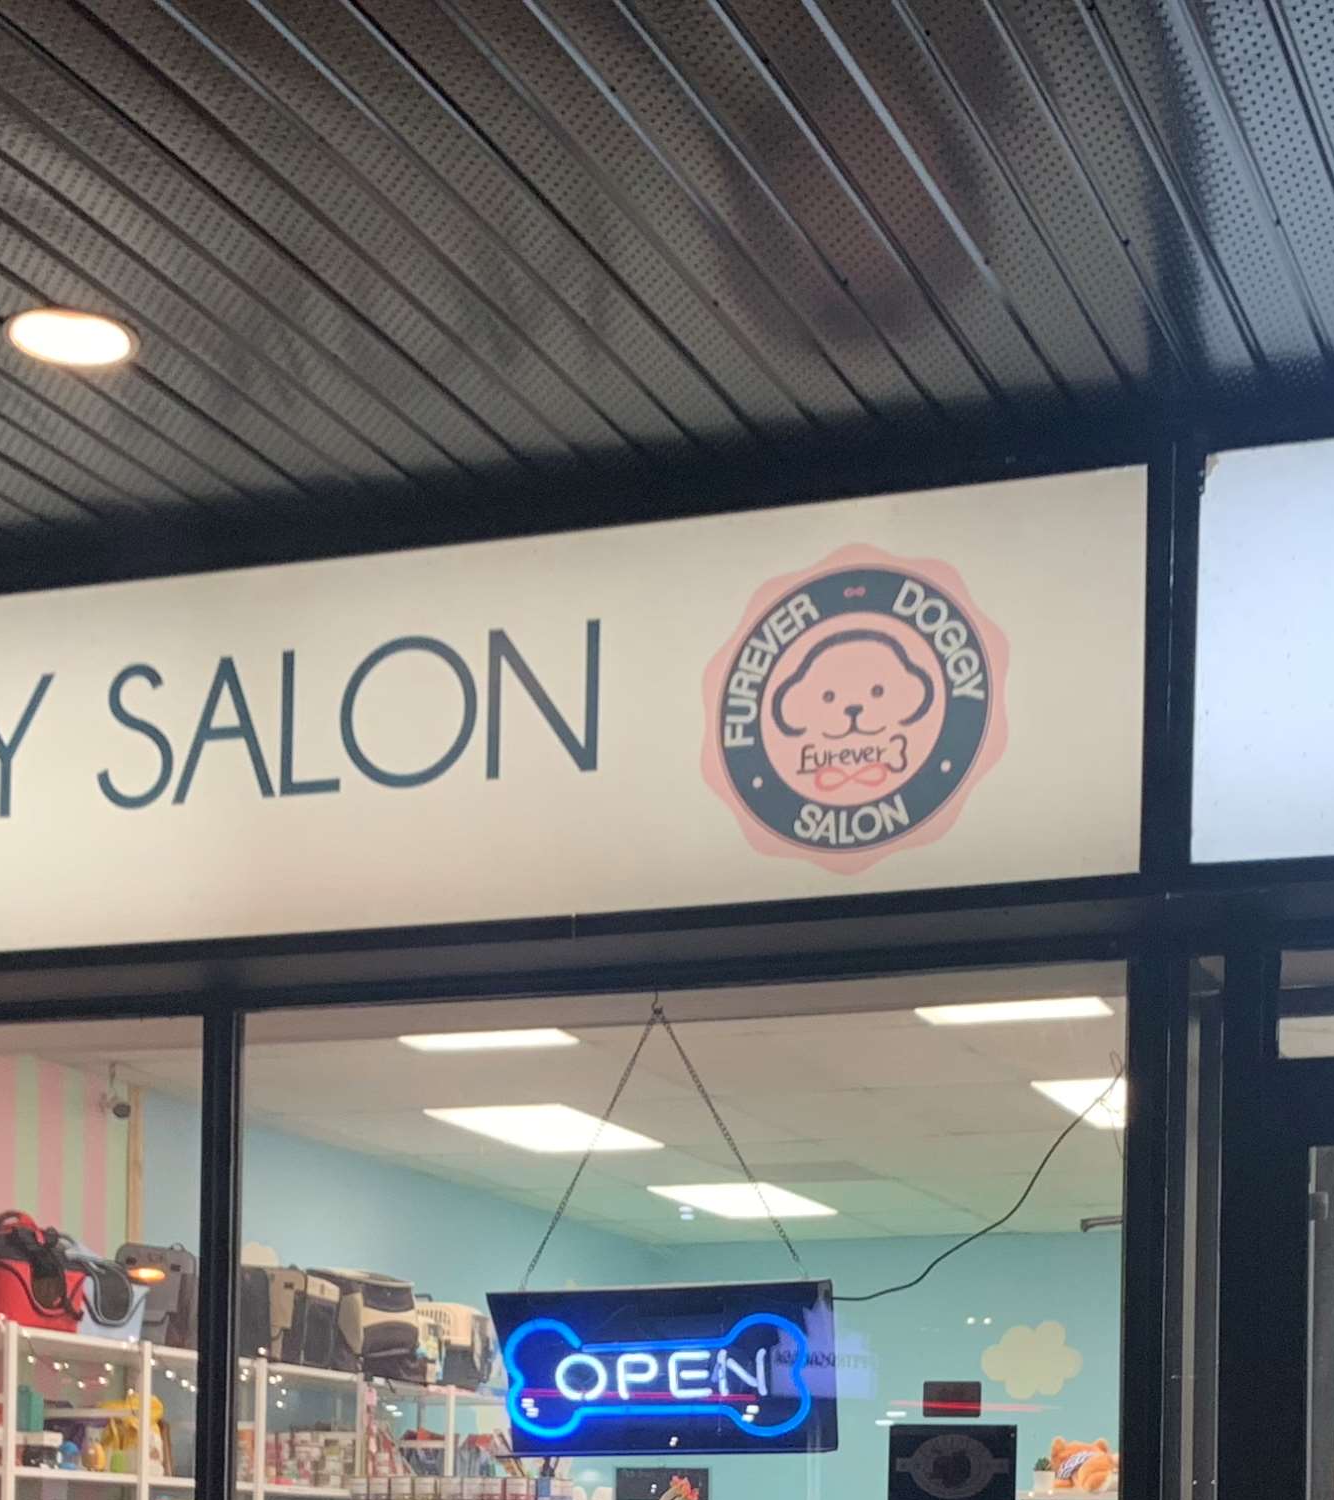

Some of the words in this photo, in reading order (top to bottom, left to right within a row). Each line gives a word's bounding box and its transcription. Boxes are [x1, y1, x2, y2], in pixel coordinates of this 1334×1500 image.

[96, 618, 601, 810] SALON
[724, 593, 819, 748] FUREVER
[892, 579, 985, 700] DOGGY
[793, 794, 910, 845] SALON
[554, 1347, 768, 1401] OPEN
